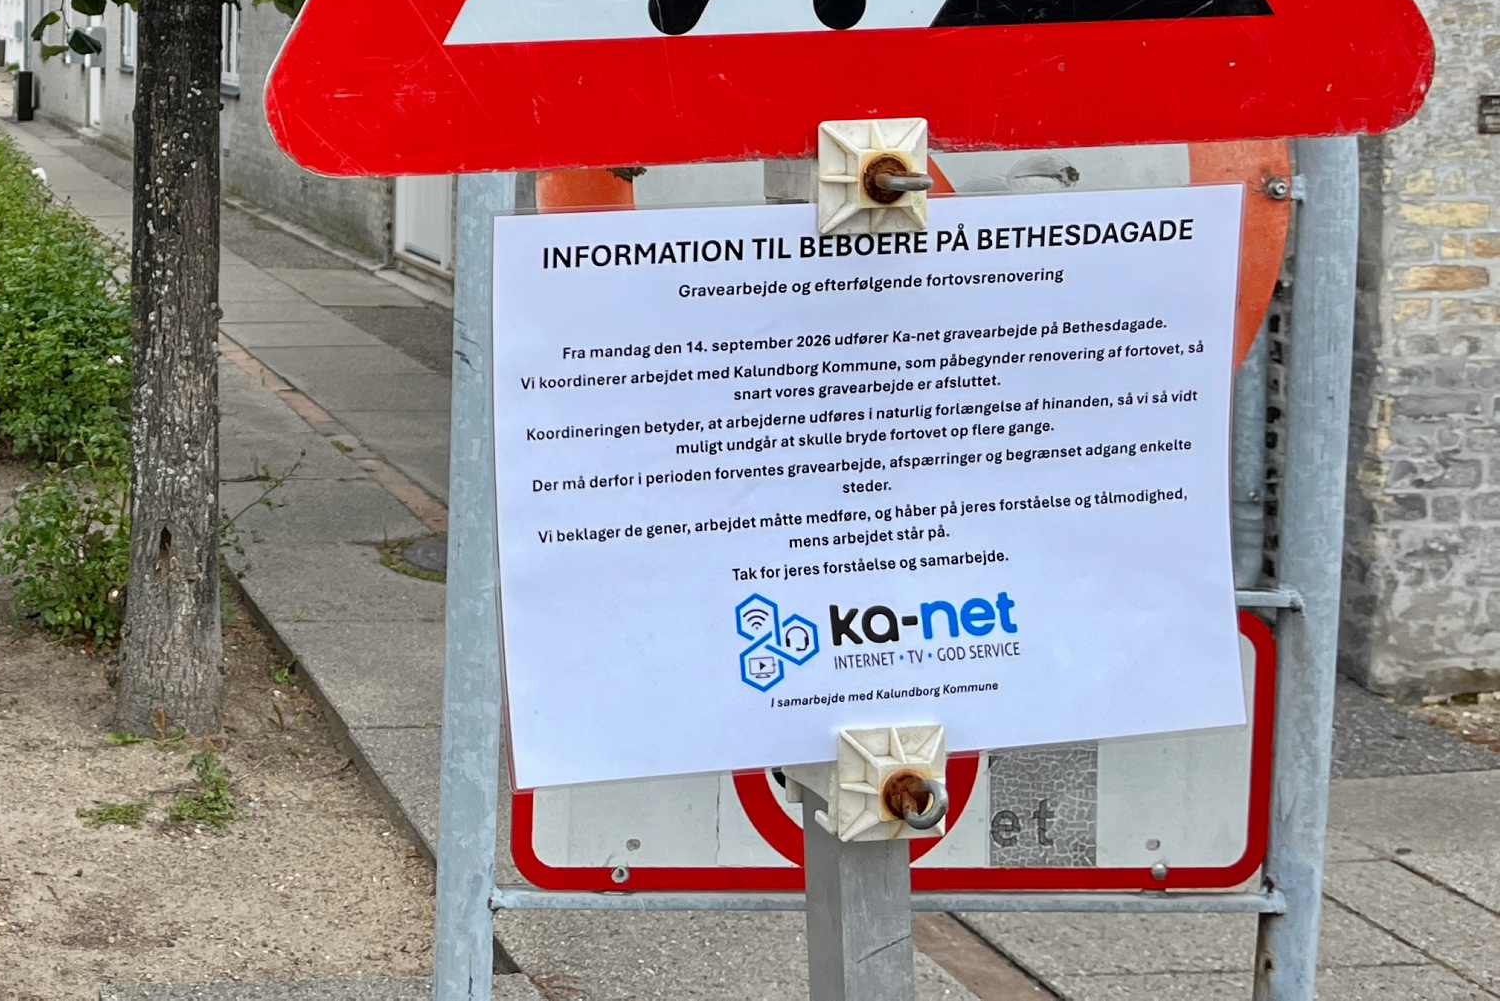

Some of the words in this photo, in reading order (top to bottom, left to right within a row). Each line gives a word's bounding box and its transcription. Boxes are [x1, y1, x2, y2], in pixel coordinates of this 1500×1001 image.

[544, 239, 743, 269] INFORMATION
[752, 238, 791, 260] TIL
[800, 231, 928, 258] BEBOERE
[937, 223, 969, 252] PÅ
[977, 219, 1193, 250] BETHESDAGADE
[679, 281, 787, 297] Gravearbejde
[792, 282, 811, 295] og
[815, 275, 922, 292] efterfølgende
[926, 268, 1063, 286] fortovsrenovering
[563, 347, 585, 359] Fra
[590, 344, 650, 358] mandag
[655, 342, 681, 354] den
[687, 341, 707, 353] 14.
[712, 337, 793, 354] september
[797, 335, 830, 347] 2026
[835, 333, 889, 345] udfører
[893, 330, 940, 342] Ka-net
[943, 324, 1037, 343] gravearbejde
[1041, 321, 1058, 338] på
[1063, 317, 1167, 333] Bethesdagade.
[521, 377, 534, 389] Vi
[540, 374, 627, 388] koordinerer
[631, 370, 693, 385] arbejdet
[697, 367, 729, 380] med
[734, 364, 819, 378] Kalundborg
[822, 361, 900, 373] Kommune,
[905, 359, 935, 369] som
[940, 352, 1025, 370] påbegynder
[1029, 347, 1104, 362] renovering
[1108, 346, 1122, 358] af
[1125, 344, 1183, 357] fortovet,
[1188, 340, 1203, 353] så
[734, 388, 772, 400] snart
[776, 387, 814, 397] vores
[819, 379, 913, 398] gravearbejde
[918, 381, 932, 390] er
[935, 375, 1000, 389] afsluttet.
[527, 424, 640, 441] Koordineringen
[645, 419, 704, 435] betyder,
[708, 418, 722, 429] at
[726, 414, 805, 429] arbejderne
[810, 410, 864, 423] udføres
[869, 408, 872, 419] i
[877, 405, 932, 419] naturlig
[935, 400, 1021, 416] forlængelse
[1025, 399, 1039, 410] af
[1043, 396, 1113, 410] hinanden,
[1118, 392, 1133, 405] så
[1137, 392, 1148, 404] vi
[1152, 390, 1167, 403] så
[1171, 390, 1197, 402] vidt
[676, 440, 723, 455] muligt
[727, 435, 777, 452] undgår
[781, 436, 794, 447] at
[799, 432, 842, 446] skulle
[846, 430, 886, 445] bryde
[890, 427, 947, 440] fortovet
[951, 427, 968, 439] op
[972, 424, 1004, 435] flere
[1009, 422, 1054, 436] gange.
[533, 480, 558, 492] Der
[563, 476, 585, 490] må
[590, 474, 634, 488] derfor
[638, 472, 641, 485] i
[646, 469, 711, 487] perioden
[715, 466, 784, 479] forventes
[788, 458, 885, 477] gravearbejde,
[890, 452, 982, 469] afspærringer
[986, 452, 1002, 464] og
[1006, 446, 1082, 462] begrænset
[1086, 443, 1136, 458] adgang
[1140, 439, 1191, 452] enkelte
[843, 480, 891, 493] steder.
[538, 530, 552, 543] Vi
[557, 528, 621, 542] beklager
[625, 525, 642, 537] de
[647, 524, 691, 538] gener,
[695, 517, 756, 532] arbejdet
[760, 513, 802, 527] måtte
[806, 510, 870, 524] medføre,
[875, 508, 892, 521] og
[895, 504, 936, 518] håber
[941, 501, 957, 518] på
[960, 501, 996, 516] jeres
[999, 495, 1070, 511] forståelse
[1075, 495, 1091, 508] og
[1094, 488, 1187, 504] tålmodighed,
[789, 537, 829, 548] mens
[833, 530, 893, 546] arbejdet
[897, 526, 924, 540] står
[928, 524, 950, 541] på.
[732, 567, 757, 580] Tak
[760, 566, 780, 578] for
[784, 564, 820, 580] jeres
[823, 558, 895, 574] forståelse
[900, 558, 917, 571] og
[920, 550, 1008, 567] samarbejde.
[829, 592, 1018, 646] ka-net
[834, 652, 895, 669] INTERNET
[907, 650, 923, 663] TV
[937, 646, 965, 661] GOD
[969, 642, 1020, 659] SERVICE
[771, 698, 774, 707] I
[777, 693, 845, 707] samarbejde
[848, 690, 873, 702] med
[876, 687, 940, 699] Kalundborg
[943, 683, 998, 694] Kommune
